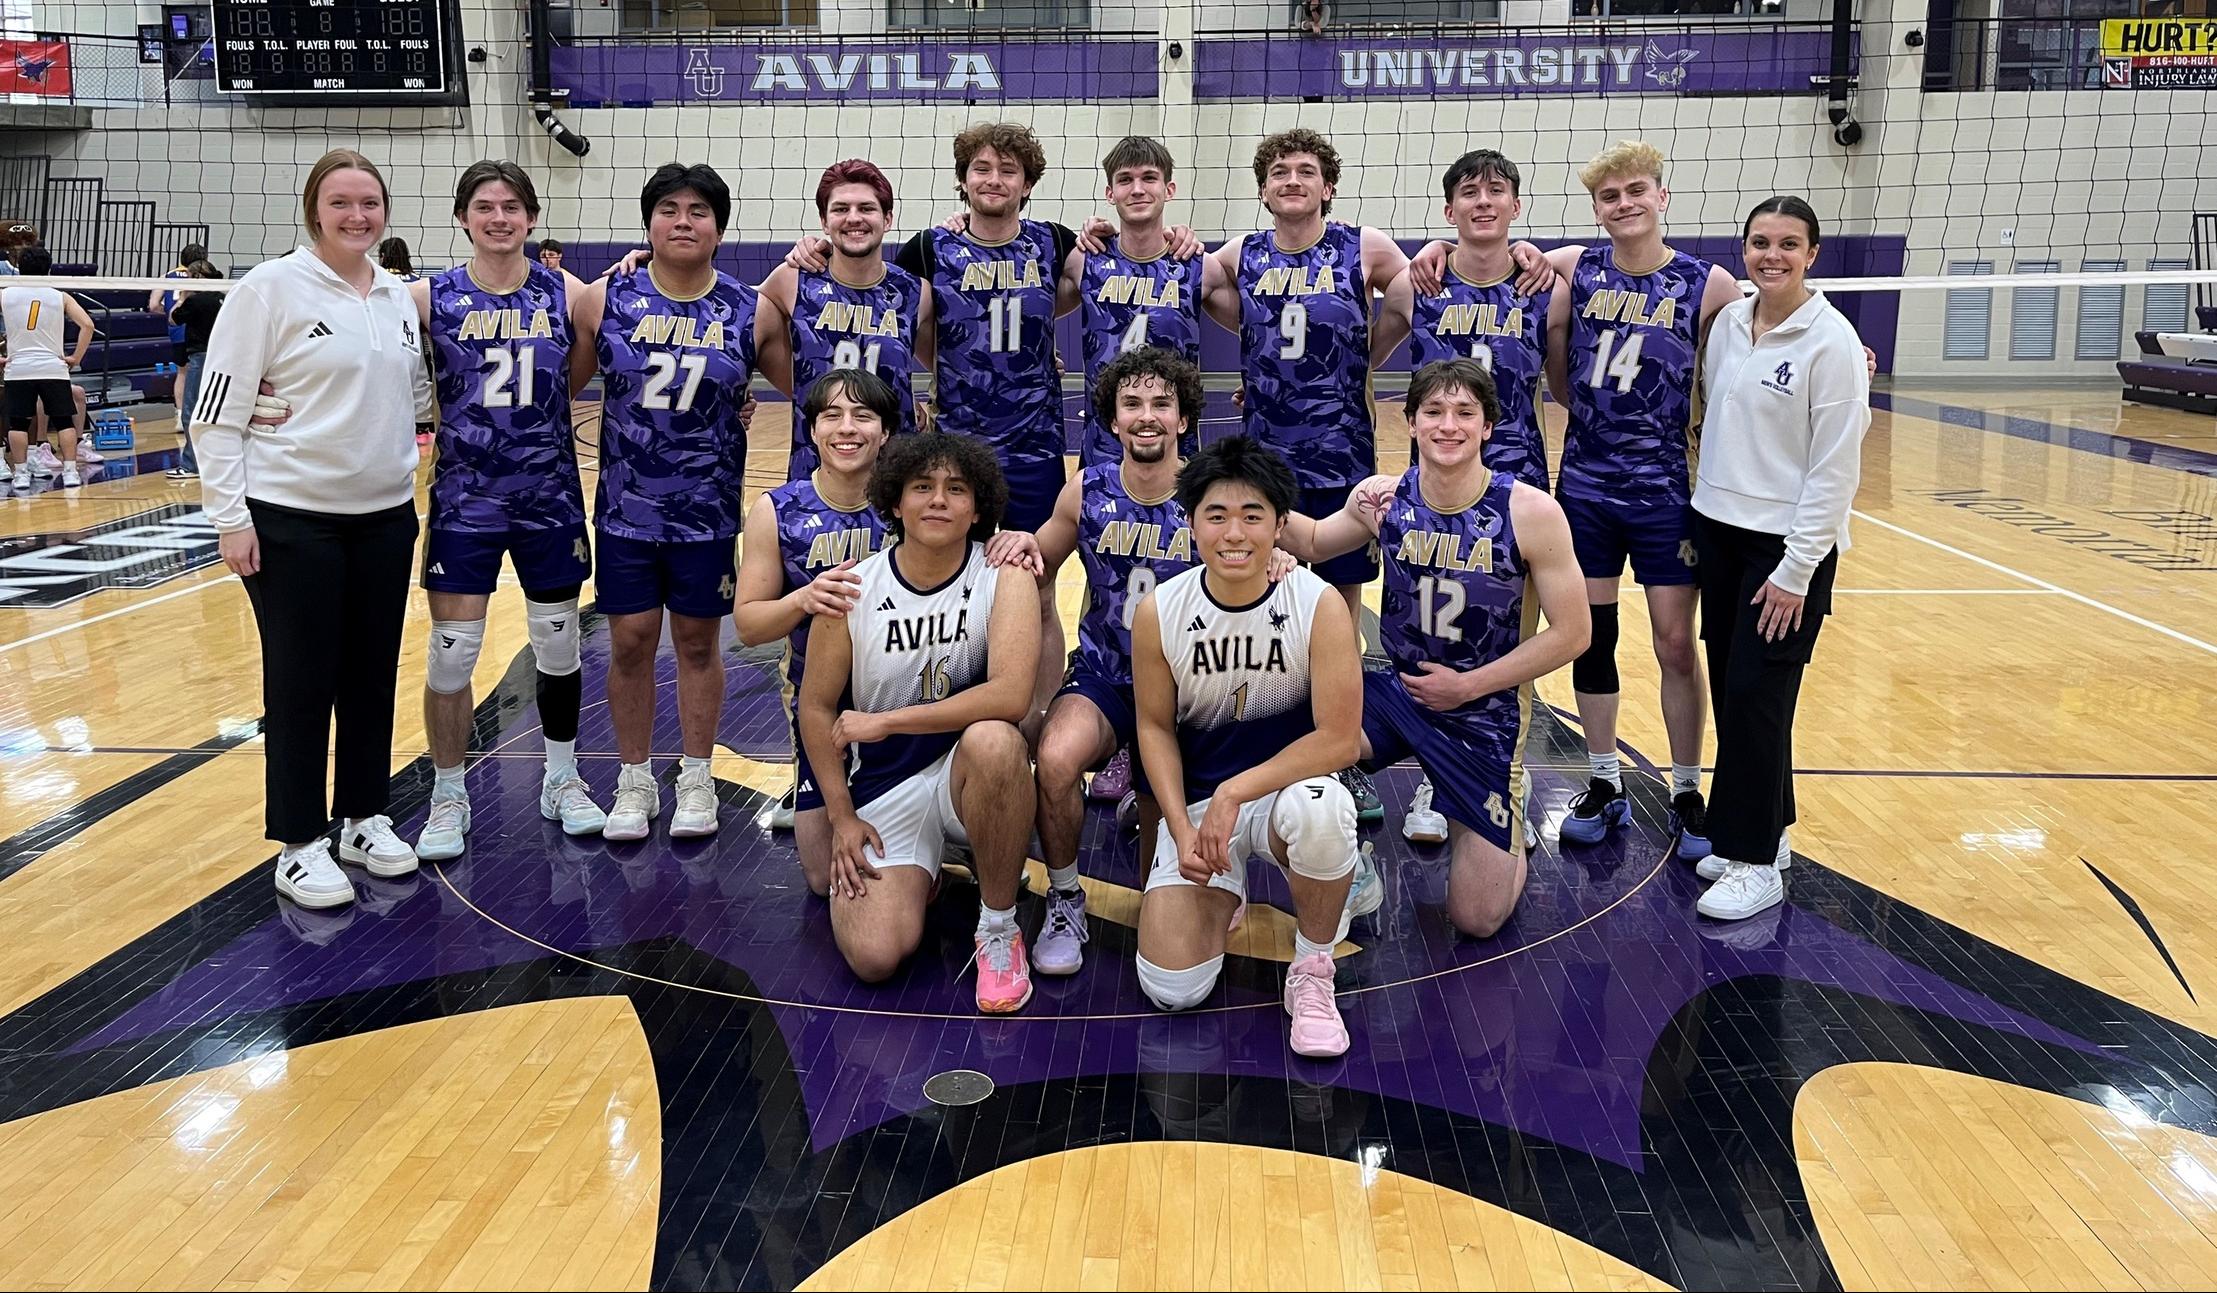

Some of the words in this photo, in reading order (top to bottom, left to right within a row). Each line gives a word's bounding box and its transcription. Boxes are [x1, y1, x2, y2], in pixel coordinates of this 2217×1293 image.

[226, 40, 255, 51] FOULS
[263, 40, 289, 50] T.O.L.
[296, 40, 330, 50] PLAYER
[334, 40, 358, 50] FOUL
[366, 39, 391, 50] T.O.L.
[400, 39, 429, 50] FOULS
[2121, 22, 2217, 53] HURT?
[232, 79, 254, 89] WON
[313, 78, 345, 89] MATCH
[403, 78, 425, 89] WON
[750, 53, 1003, 91] AVILA
[1339, 46, 1642, 88] UNIVERSITY
[2139, 67, 2217, 75] NORTHLAND
[2139, 73, 2186, 87] INJURY
[2189, 73, 2217, 86] LAW
[961, 259, 1042, 292] AVILA
[1097, 275, 1180, 309] AVILA
[1253, 265, 1335, 296] AVILA
[27, 300, 41, 330] 1
[457, 308, 553, 341] AVILA
[814, 300, 899, 338] AVILA
[987, 297, 1022, 353] 11
[1435, 303, 1522, 339] AVILA
[1582, 288, 1676, 330] AVILA
[630, 314, 725, 351] AVILA
[1280, 302, 1307, 361] 9
[482, 345, 535, 409] 21
[1589, 328, 1643, 394] 14
[641, 350, 708, 412] 27
[1096, 520, 1191, 562] AVILA
[1395, 529, 1493, 573] AVILA
[1417, 575, 1467, 642] 12
[885, 609, 969, 653] AVILA
[1192, 635, 1286, 675] AVILA
[918, 655, 952, 701] 16
[1231, 681, 1249, 722] 1
